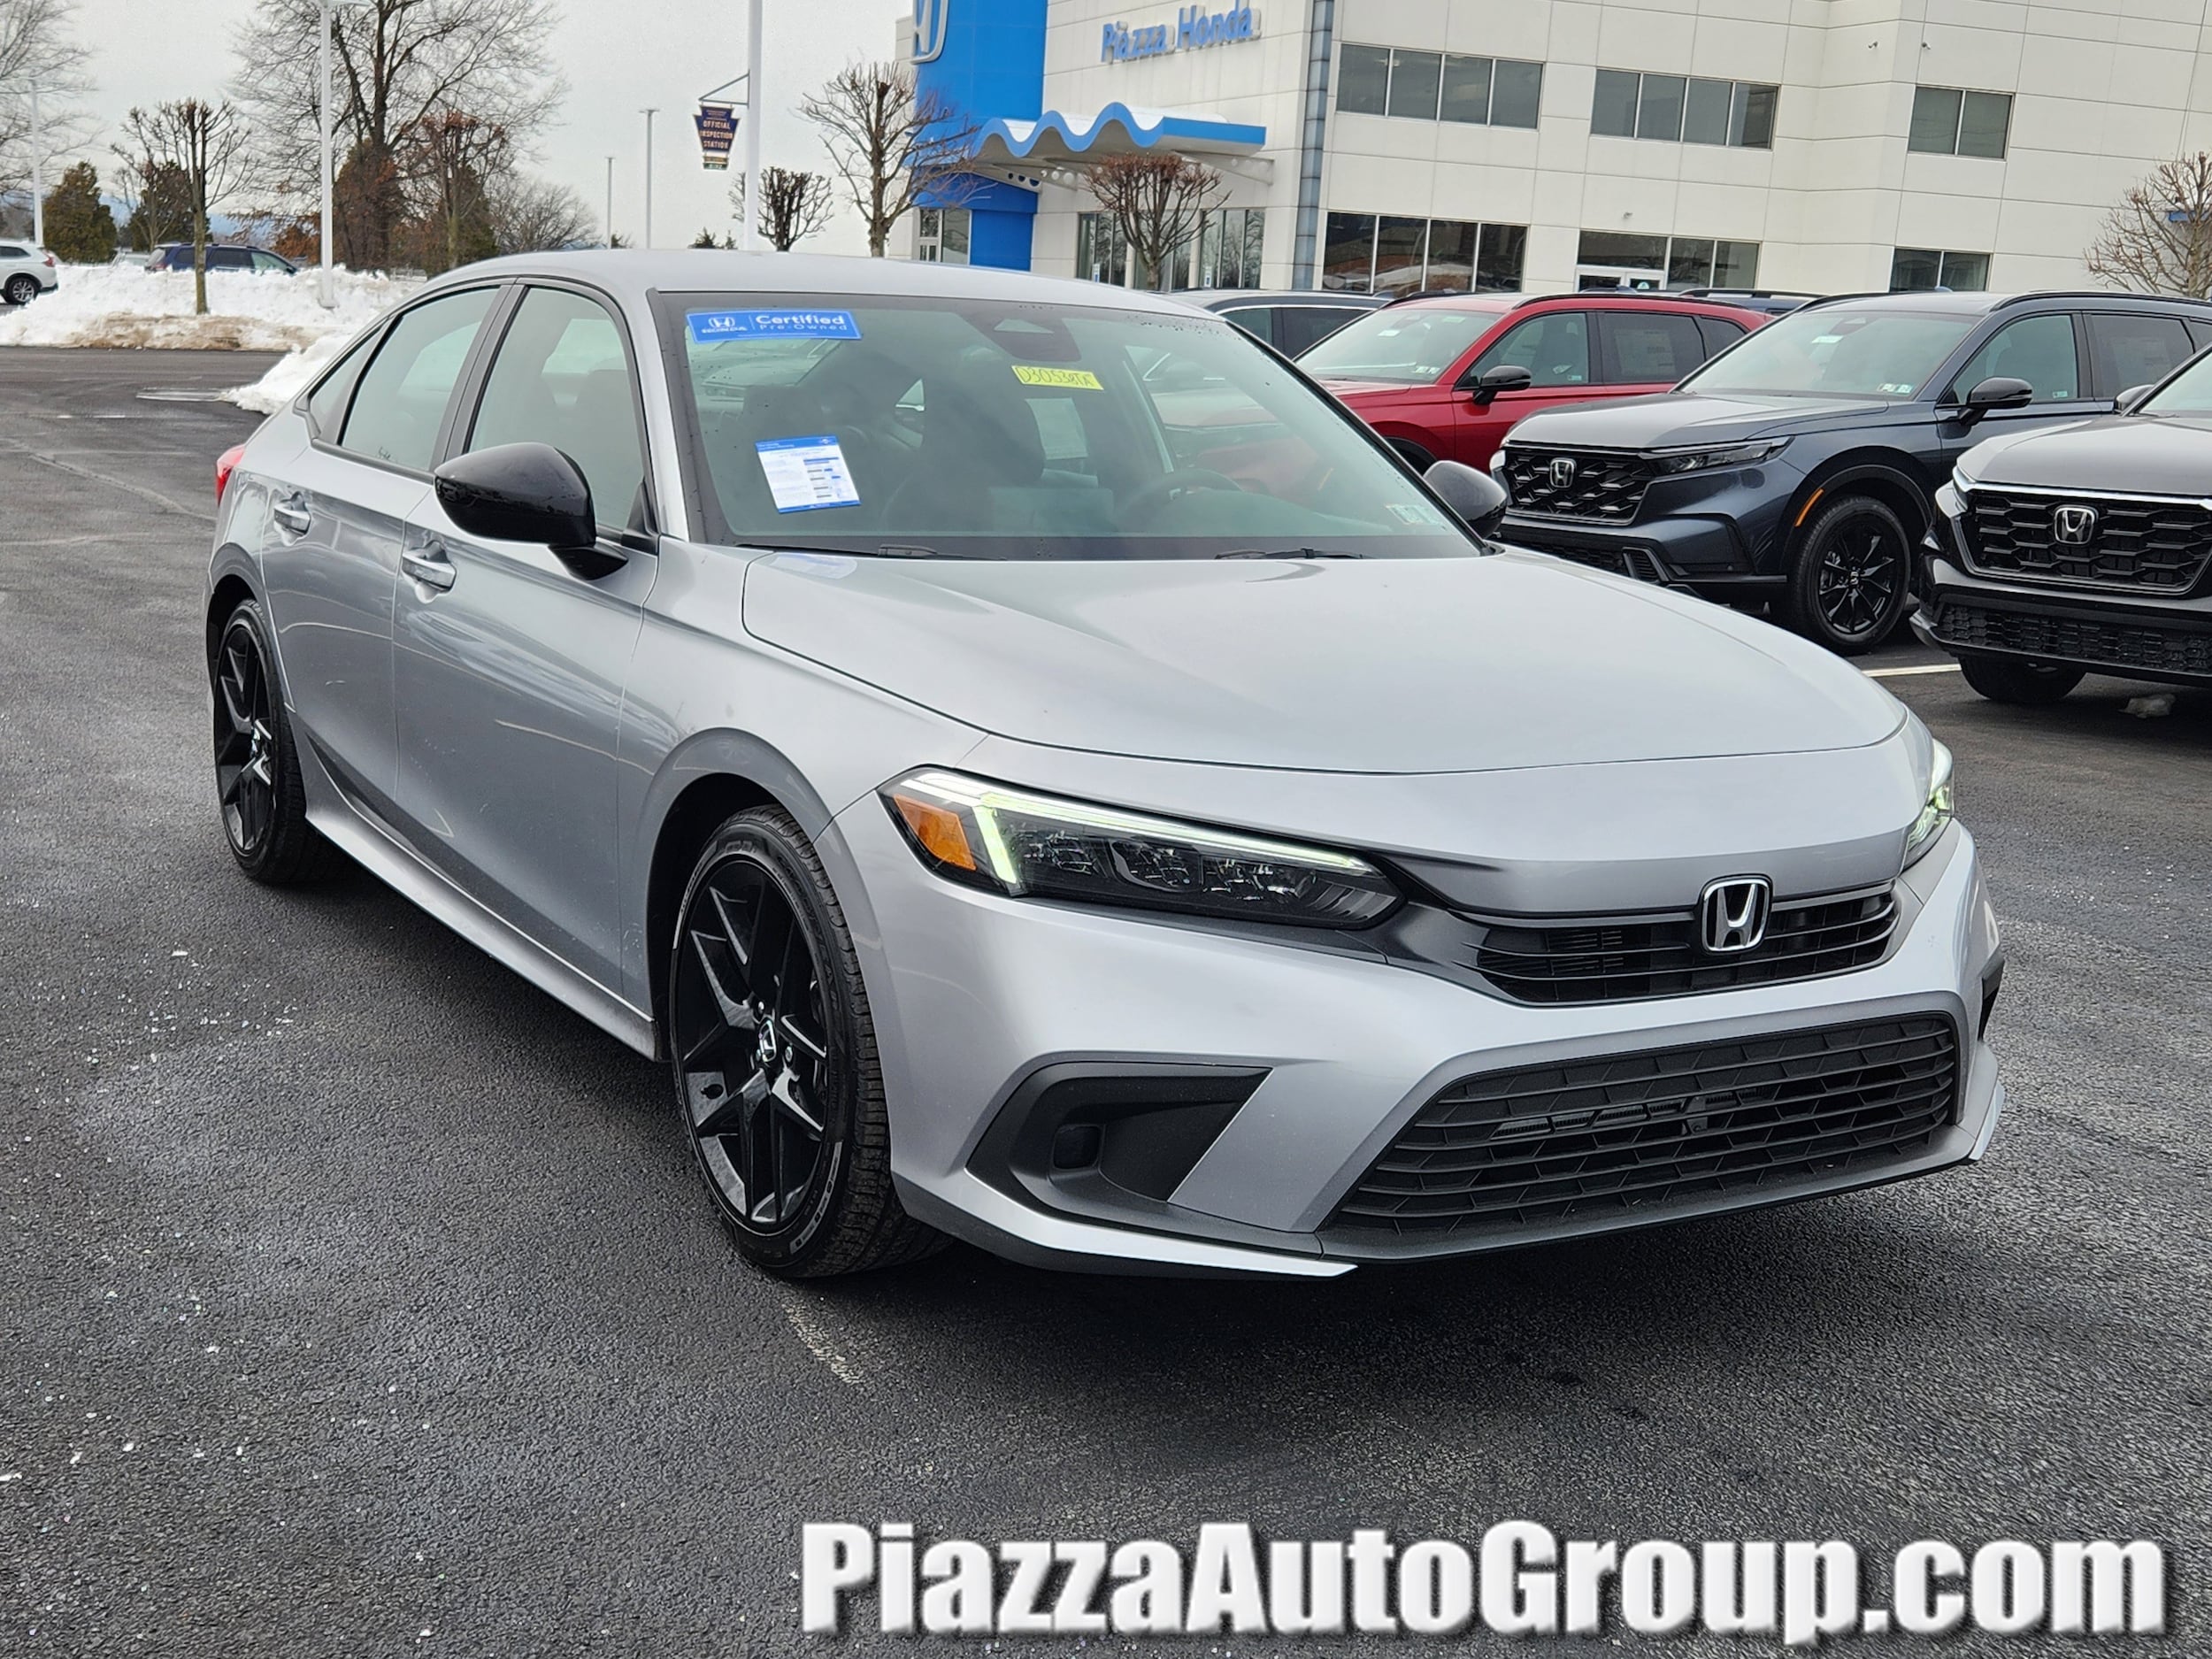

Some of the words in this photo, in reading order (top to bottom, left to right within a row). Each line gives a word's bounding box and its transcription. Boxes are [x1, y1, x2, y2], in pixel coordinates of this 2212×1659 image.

[1101, 20, 1168, 63] Piazza
[1176, 0, 1254, 49] Honda
[703, 119, 731, 130] OFFICIAL
[699, 130, 733, 140] INSPECTION
[703, 140, 729, 150] STATION
[756, 314, 845, 325] Certified
